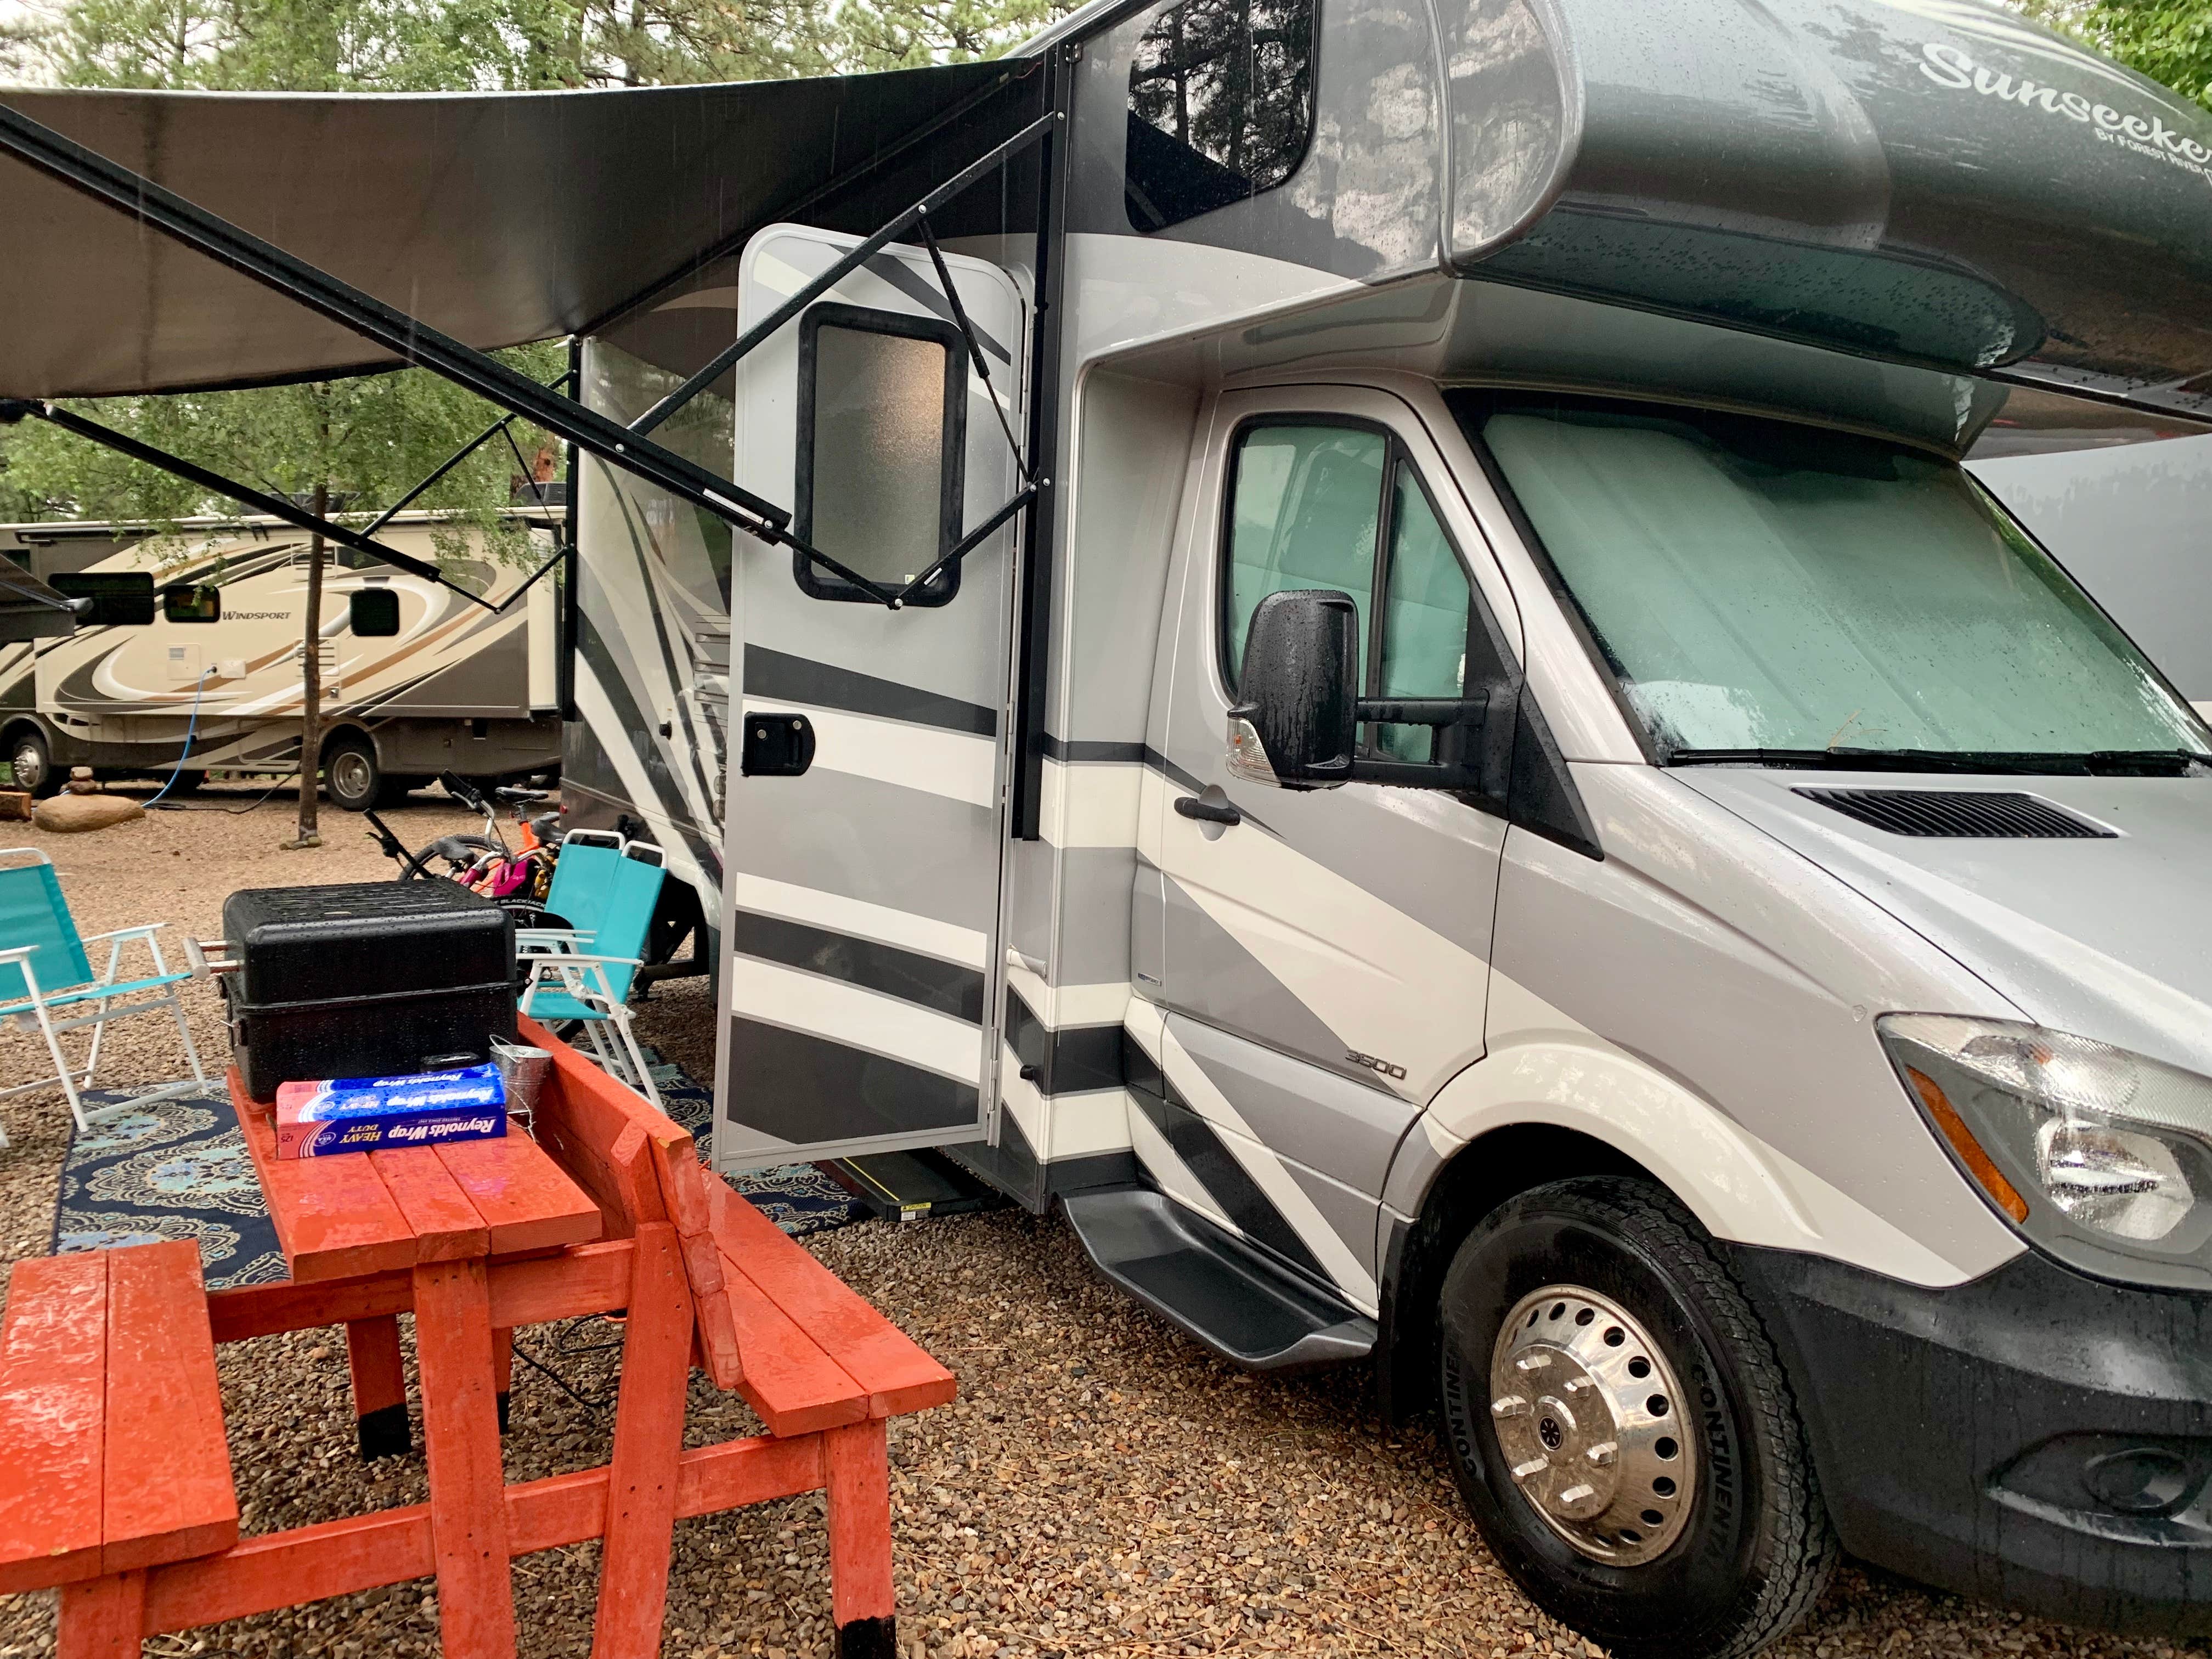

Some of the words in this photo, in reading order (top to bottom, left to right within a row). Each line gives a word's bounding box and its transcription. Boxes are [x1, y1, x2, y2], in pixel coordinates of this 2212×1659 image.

[1919, 43, 2212, 163] Sunseeke
[2117, 134, 2166, 161] FOREST
[222, 611, 291, 620] WINDSPORT
[1345, 1049, 1407, 1080] 3500
[408, 1072, 463, 1085] Reynolds
[386, 1096, 426, 1107] Wrap
[427, 1088, 494, 1104] Reynolds
[347, 1124, 379, 1133] DUTY
[388, 1125, 428, 1141] Wrap
[428, 1117, 496, 1137] Reynolds
[280, 1135, 294, 1143] 125
[338, 1131, 382, 1144] HEAVY
